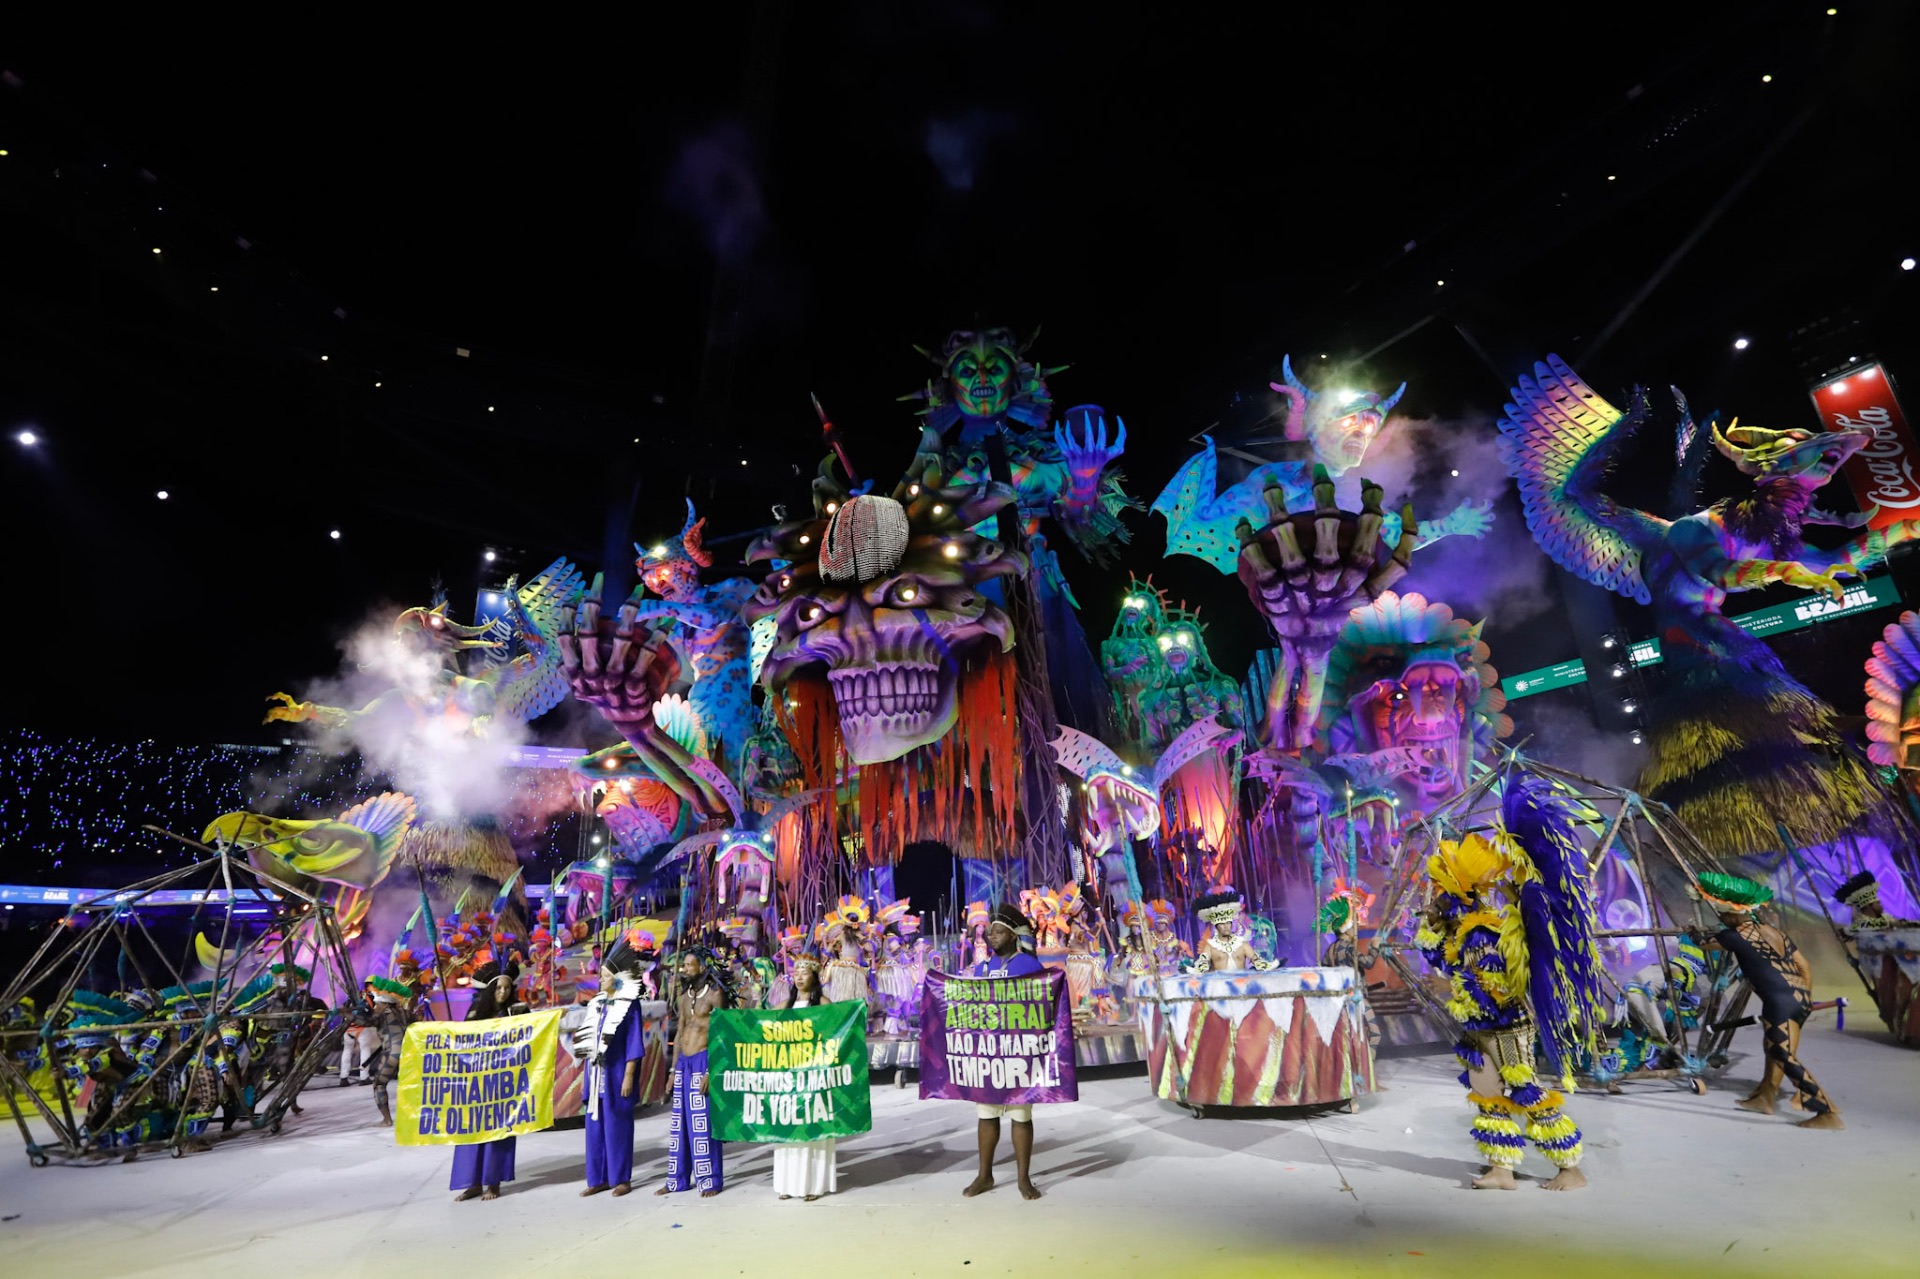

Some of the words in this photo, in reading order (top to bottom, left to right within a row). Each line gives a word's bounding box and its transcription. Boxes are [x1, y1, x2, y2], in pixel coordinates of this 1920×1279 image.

[944, 978, 991, 1002] NOSSO
[993, 977, 1042, 1002] MANTO
[1047, 974, 1055, 1002] É
[945, 1002, 1056, 1030] ANCESTRAL!
[425, 1034, 451, 1050] PELA
[454, 1024, 534, 1050] DEMARCAÇÃO
[762, 1018, 814, 1043] SOMOS
[945, 1029, 974, 1055] NÃO
[977, 1034, 997, 1056] AO
[1000, 1030, 1057, 1056] MARCO
[422, 1053, 442, 1074] DO
[735, 1033, 841, 1069] TUPINAMBÁS!
[723, 1069, 794, 1093] QUEREMOS
[796, 1070, 805, 1092] O
[807, 1064, 852, 1092] MANTO
[945, 1053, 1061, 1090] TEMPORAL!
[418, 1107, 441, 1135] DE
[445, 1095, 536, 1135] OLIVENÇA!
[743, 1093, 765, 1125] DE
[768, 1090, 834, 1126] VOLTA!
